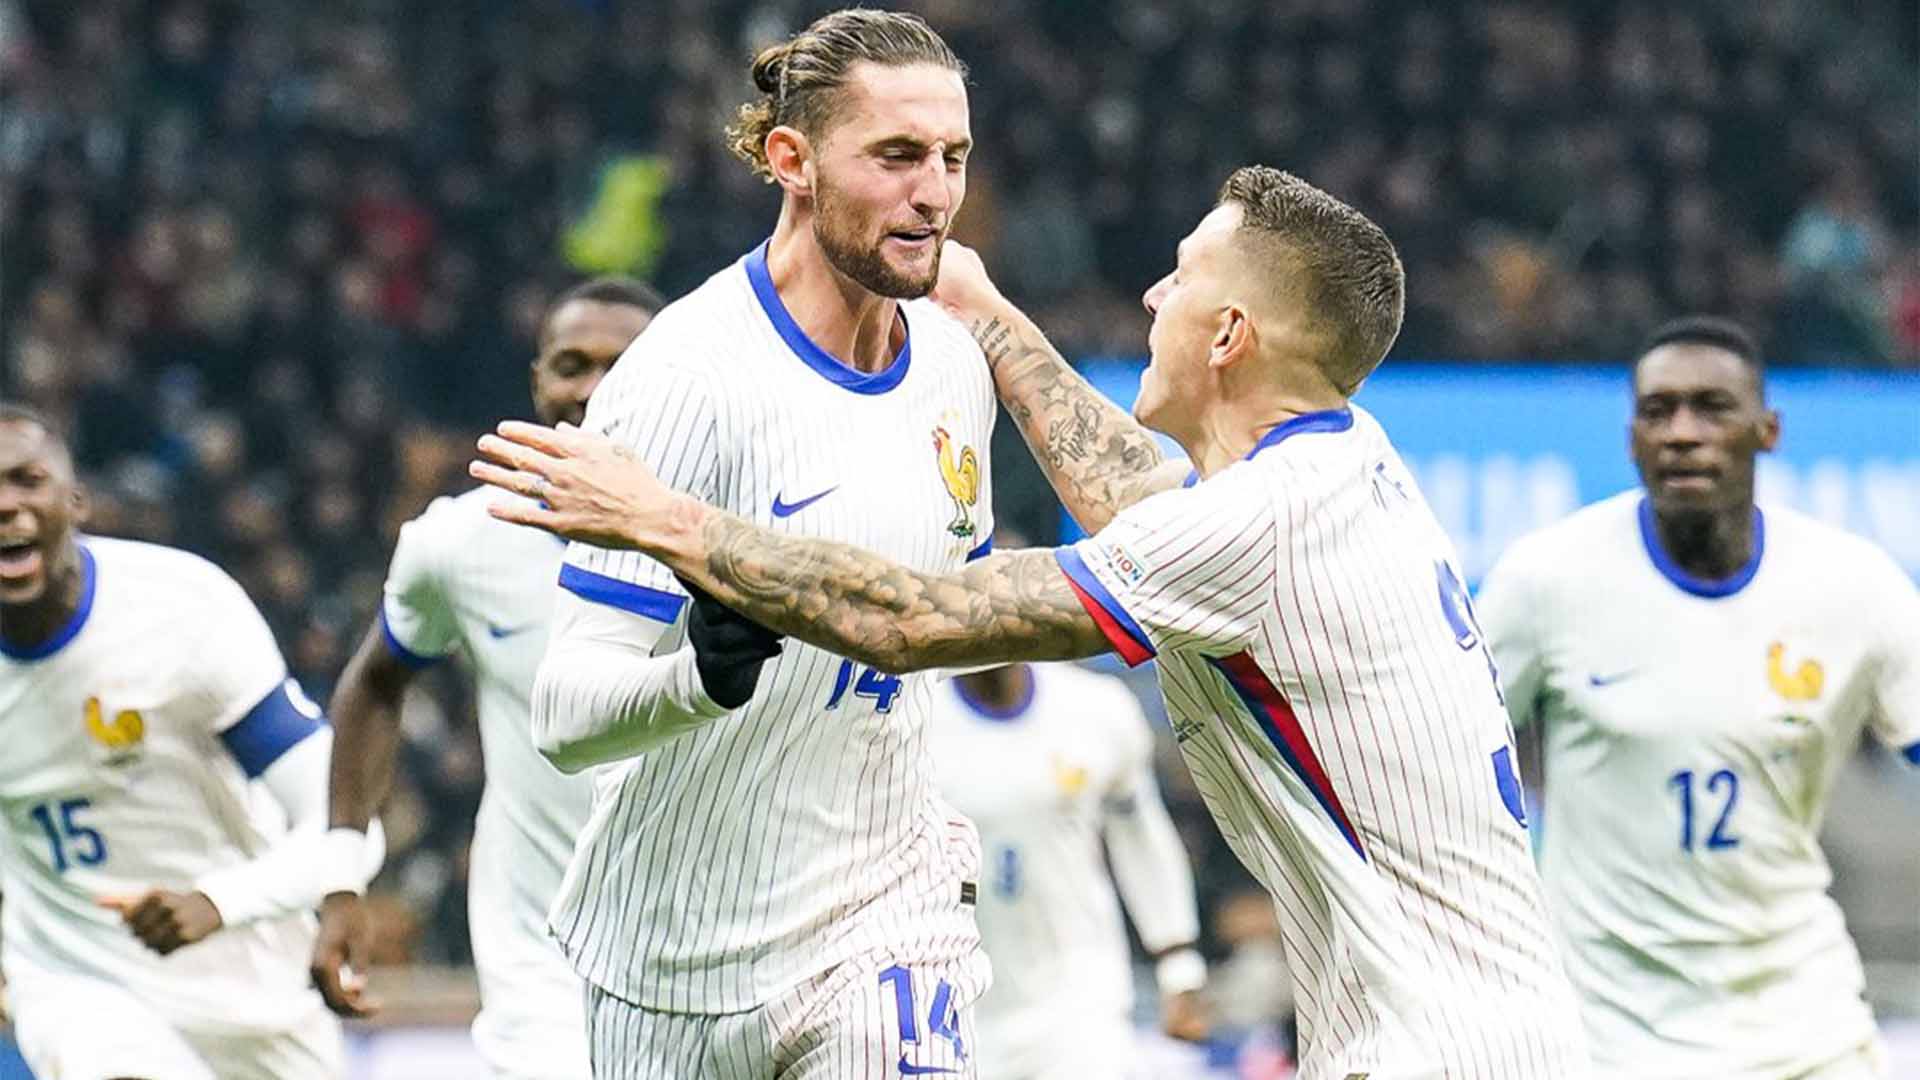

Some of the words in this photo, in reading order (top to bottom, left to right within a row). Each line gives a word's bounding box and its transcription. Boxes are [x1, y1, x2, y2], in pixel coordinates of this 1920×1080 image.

[825, 656, 903, 713] 14
[31, 797, 107, 873] 15
[1665, 768, 1739, 853] 12
[878, 964, 967, 1063] 14
